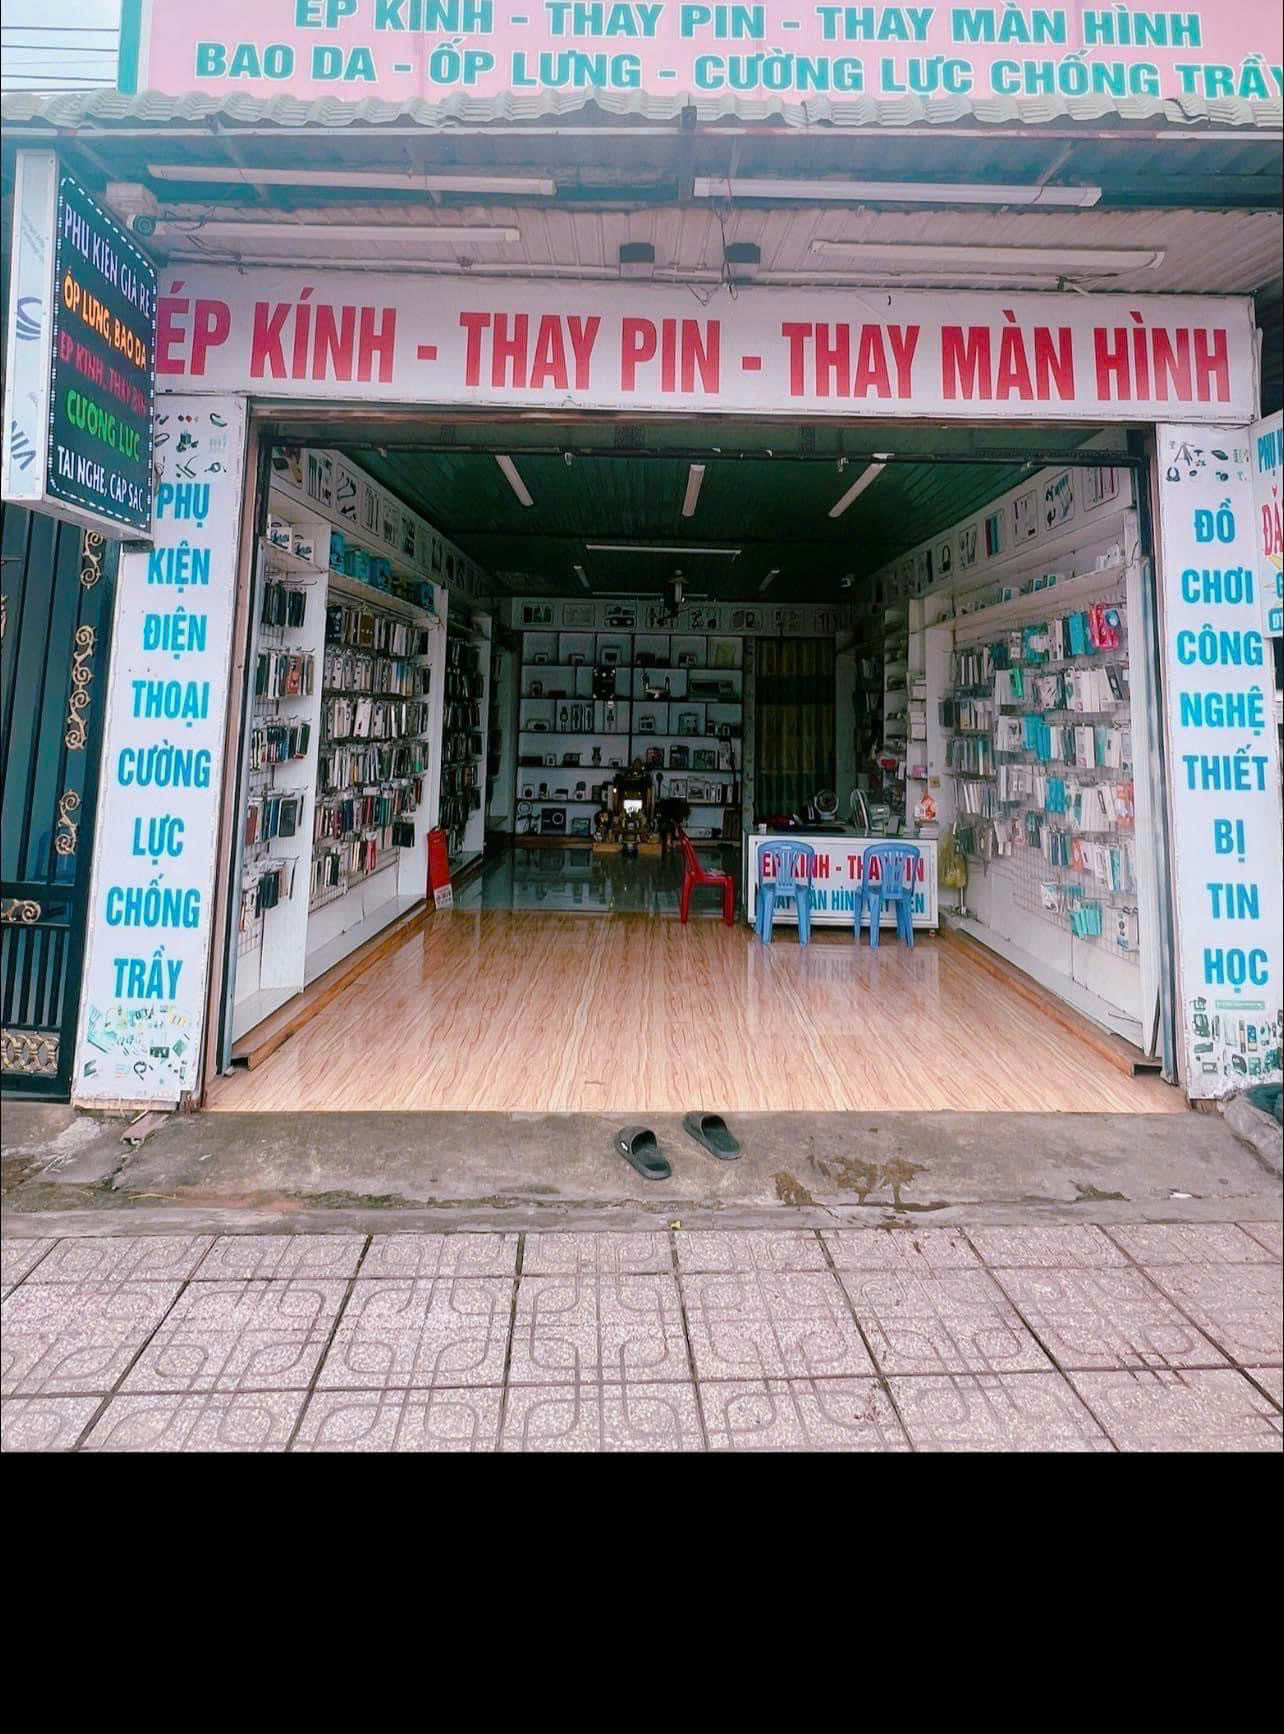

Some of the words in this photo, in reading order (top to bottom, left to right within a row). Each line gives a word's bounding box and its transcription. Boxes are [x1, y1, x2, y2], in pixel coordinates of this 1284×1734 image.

[546, 3, 662, 37] THAY
[681, 5, 765, 39] PIN
[817, 7, 934, 41] THAY
[952, 2, 1067, 44] MÀN
[1083, 4, 1201, 47] HÌNH
[196, 43, 294, 79] BAO
[312, 45, 377, 81] DA
[430, 38, 494, 84] ỐP
[512, 50, 641, 88] LƯNG
[695, 48, 863, 91] CƯỜNG
[882, 56, 972, 101] LỰC
[993, 49, 1160, 96] CHỐNG
[114, 317, 133, 360] BAO
[135, 336, 147, 372] DA
[156, 281, 231, 375] ÉP
[250, 287, 397, 384] KÍNH
[417, 345, 437, 360] -
[460, 312, 601, 390] THAY
[621, 317, 720, 393] PIN
[742, 356, 761, 370] -
[782, 321, 920, 399] THAY
[941, 309, 1075, 401] MÀN
[1094, 310, 1230, 403] HÌNH
[57, 445, 75, 480] TAI
[76, 455, 108, 497] NGHE,
[157, 482, 210, 527] PHỤ
[1194, 498, 1236, 543] ĐỒ
[148, 541, 211, 593] KIỆN
[1182, 566, 1254, 604] CHƠI
[144, 607, 207, 660] ĐIỆN
[1176, 623, 1263, 666] CÔNG
[132, 680, 210, 728] THOẠI
[1179, 686, 1265, 736] NGHỆ
[118, 739, 211, 787] CƯỜNG
[1182, 744, 1268, 791] THIẾT
[132, 814, 185, 865] LỰC
[1214, 819, 1245, 863] BỊ
[106, 874, 201, 928] CHỐNG
[1207, 882, 1259, 920] TIN
[113, 945, 183, 1000] TRẦY
[1203, 948, 1269, 994] HỌC
